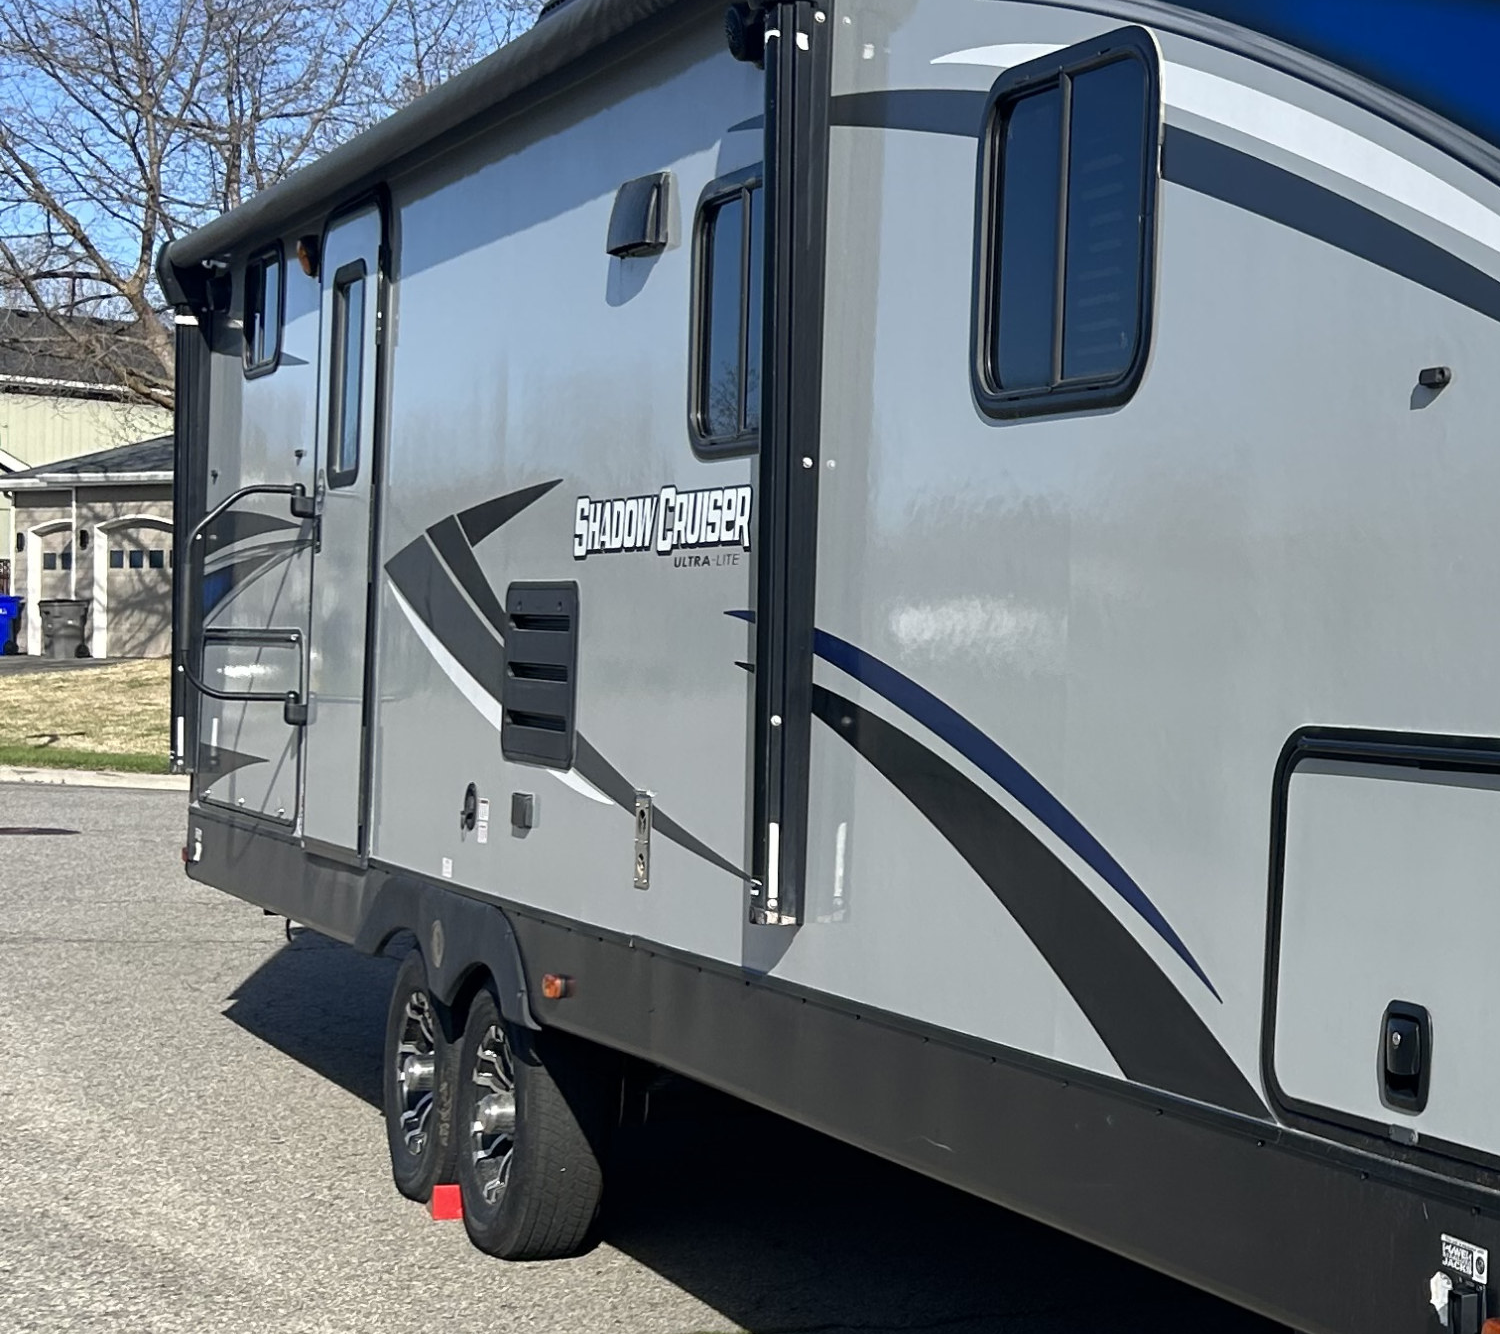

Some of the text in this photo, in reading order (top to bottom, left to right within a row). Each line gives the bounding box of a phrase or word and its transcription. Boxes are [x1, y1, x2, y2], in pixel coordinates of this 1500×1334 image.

[573, 485, 752, 559] SHADOW CRUISER
[673, 553, 741, 568] ULTRA-LITE
